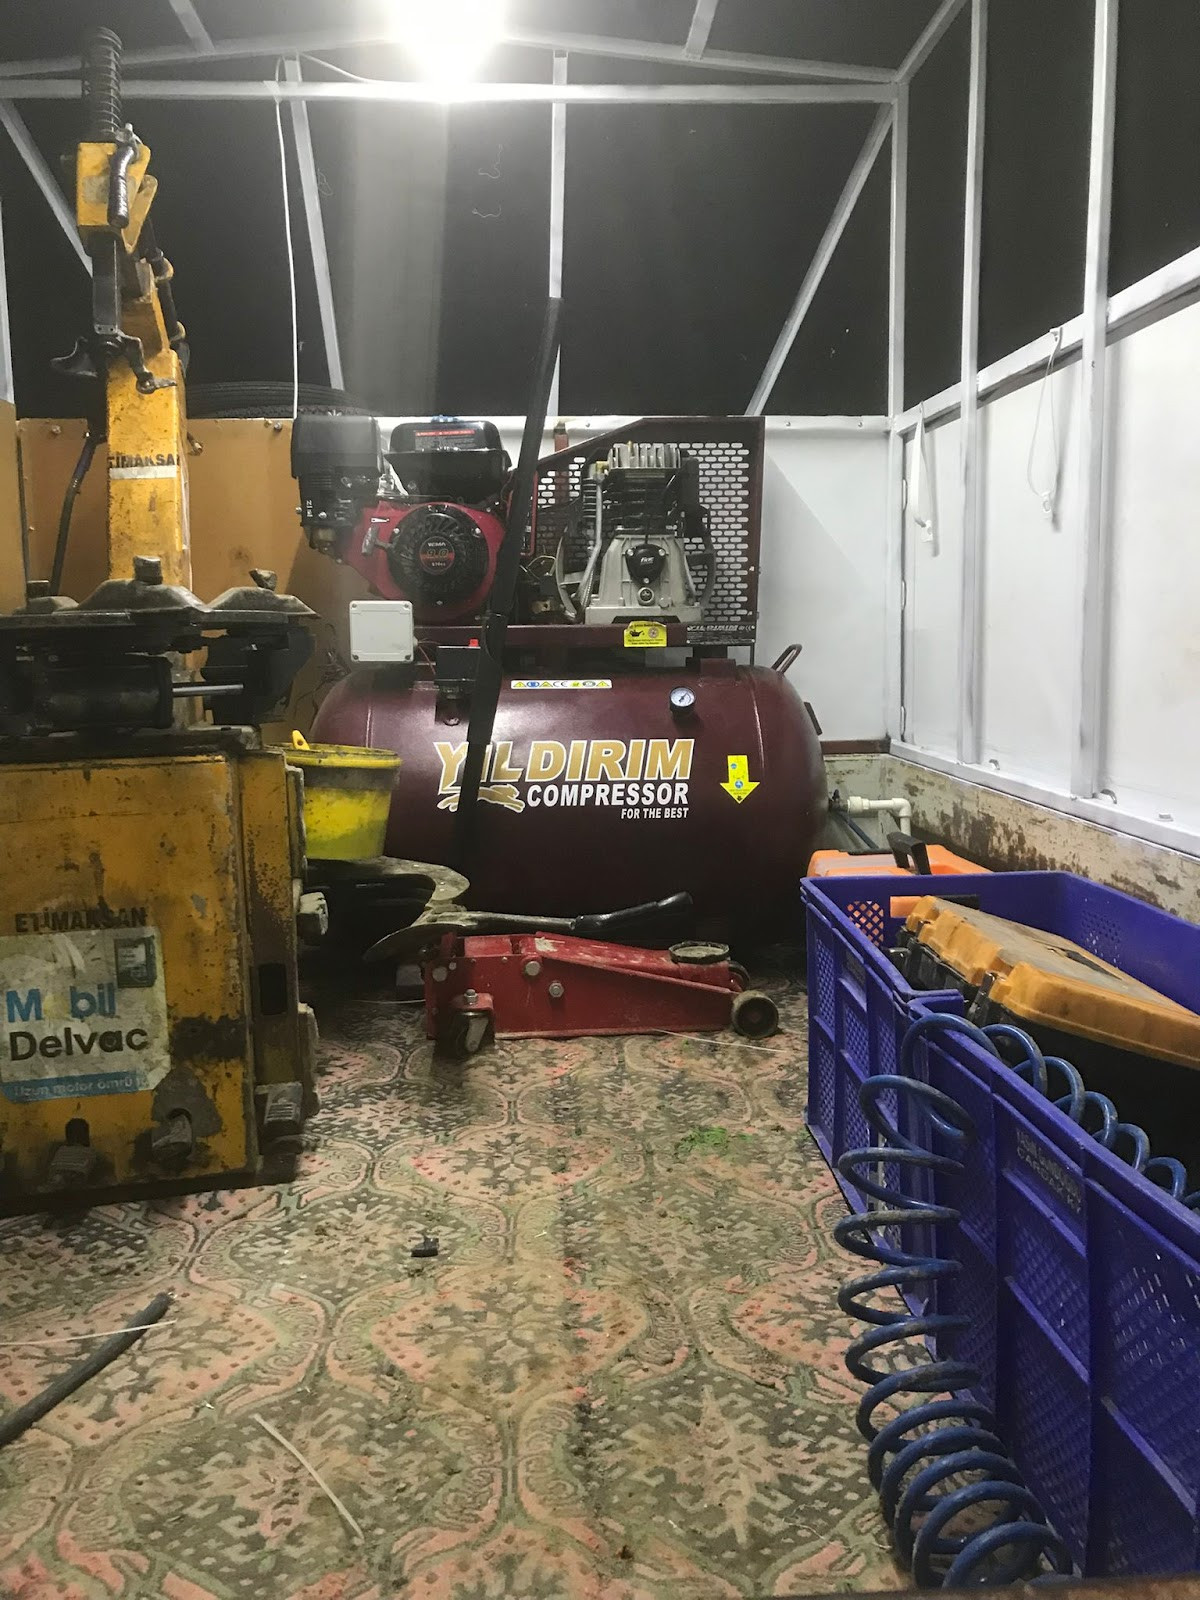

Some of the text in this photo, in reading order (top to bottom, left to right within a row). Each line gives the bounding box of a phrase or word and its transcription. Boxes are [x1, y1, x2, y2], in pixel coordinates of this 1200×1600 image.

[526, 782, 689, 807] COMPRESSOR
[621, 807, 689, 819] FOR THE BEST
[5, 983, 117, 1023] Mbil
[9, 1027, 149, 1061] Delvac
[53, 1081, 93, 1094] motor
